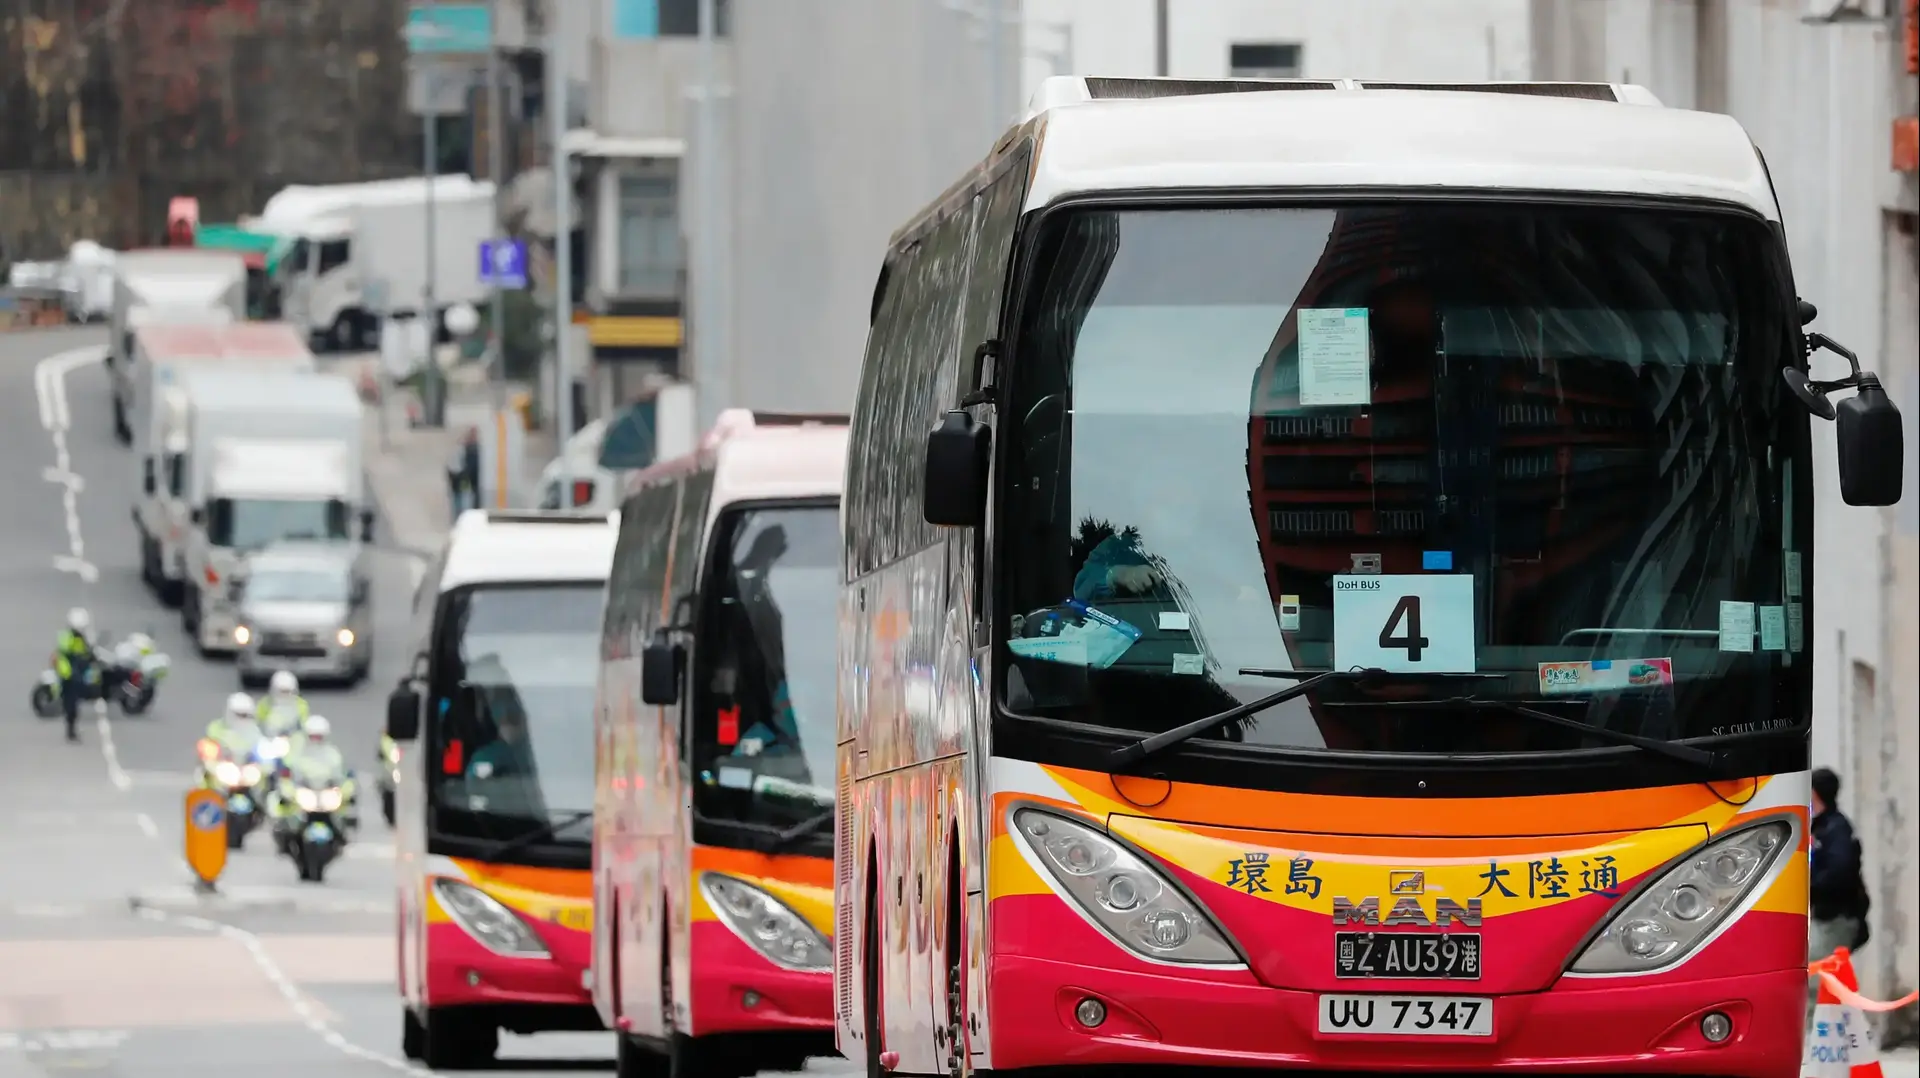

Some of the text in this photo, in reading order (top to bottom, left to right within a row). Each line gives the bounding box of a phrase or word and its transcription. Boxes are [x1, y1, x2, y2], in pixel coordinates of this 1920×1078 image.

[1337, 580, 1381, 590] DoH BUS
[1379, 595, 1429, 662] 4
[1226, 852, 1622, 900] 環島 大陸通
[1333, 896, 1482, 927] MAN
[1329, 1000, 1482, 1030] UU 7347
